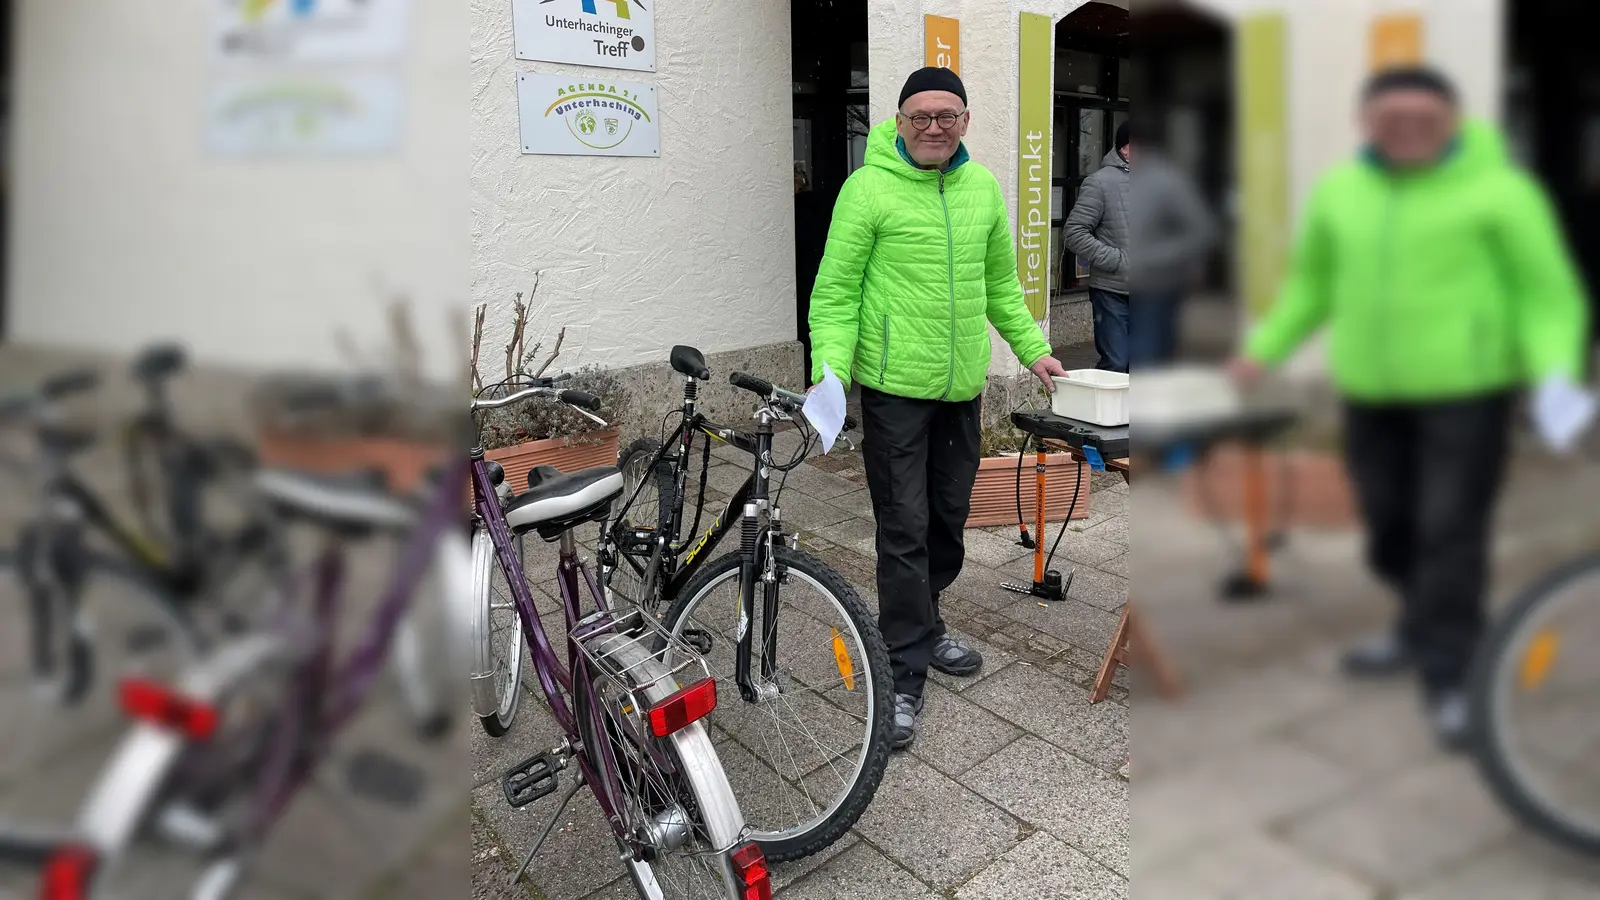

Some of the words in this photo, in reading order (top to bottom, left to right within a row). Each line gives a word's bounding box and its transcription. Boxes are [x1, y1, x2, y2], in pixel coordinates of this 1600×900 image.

[545, 15, 633, 38] Unterhachinger
[593, 39, 630, 57] Treff
[557, 83, 616, 96] AGENDA
[623, 90, 638, 102] 21
[555, 98, 642, 121] Unterhaching
[1020, 130, 1043, 295] Treffpunkt
